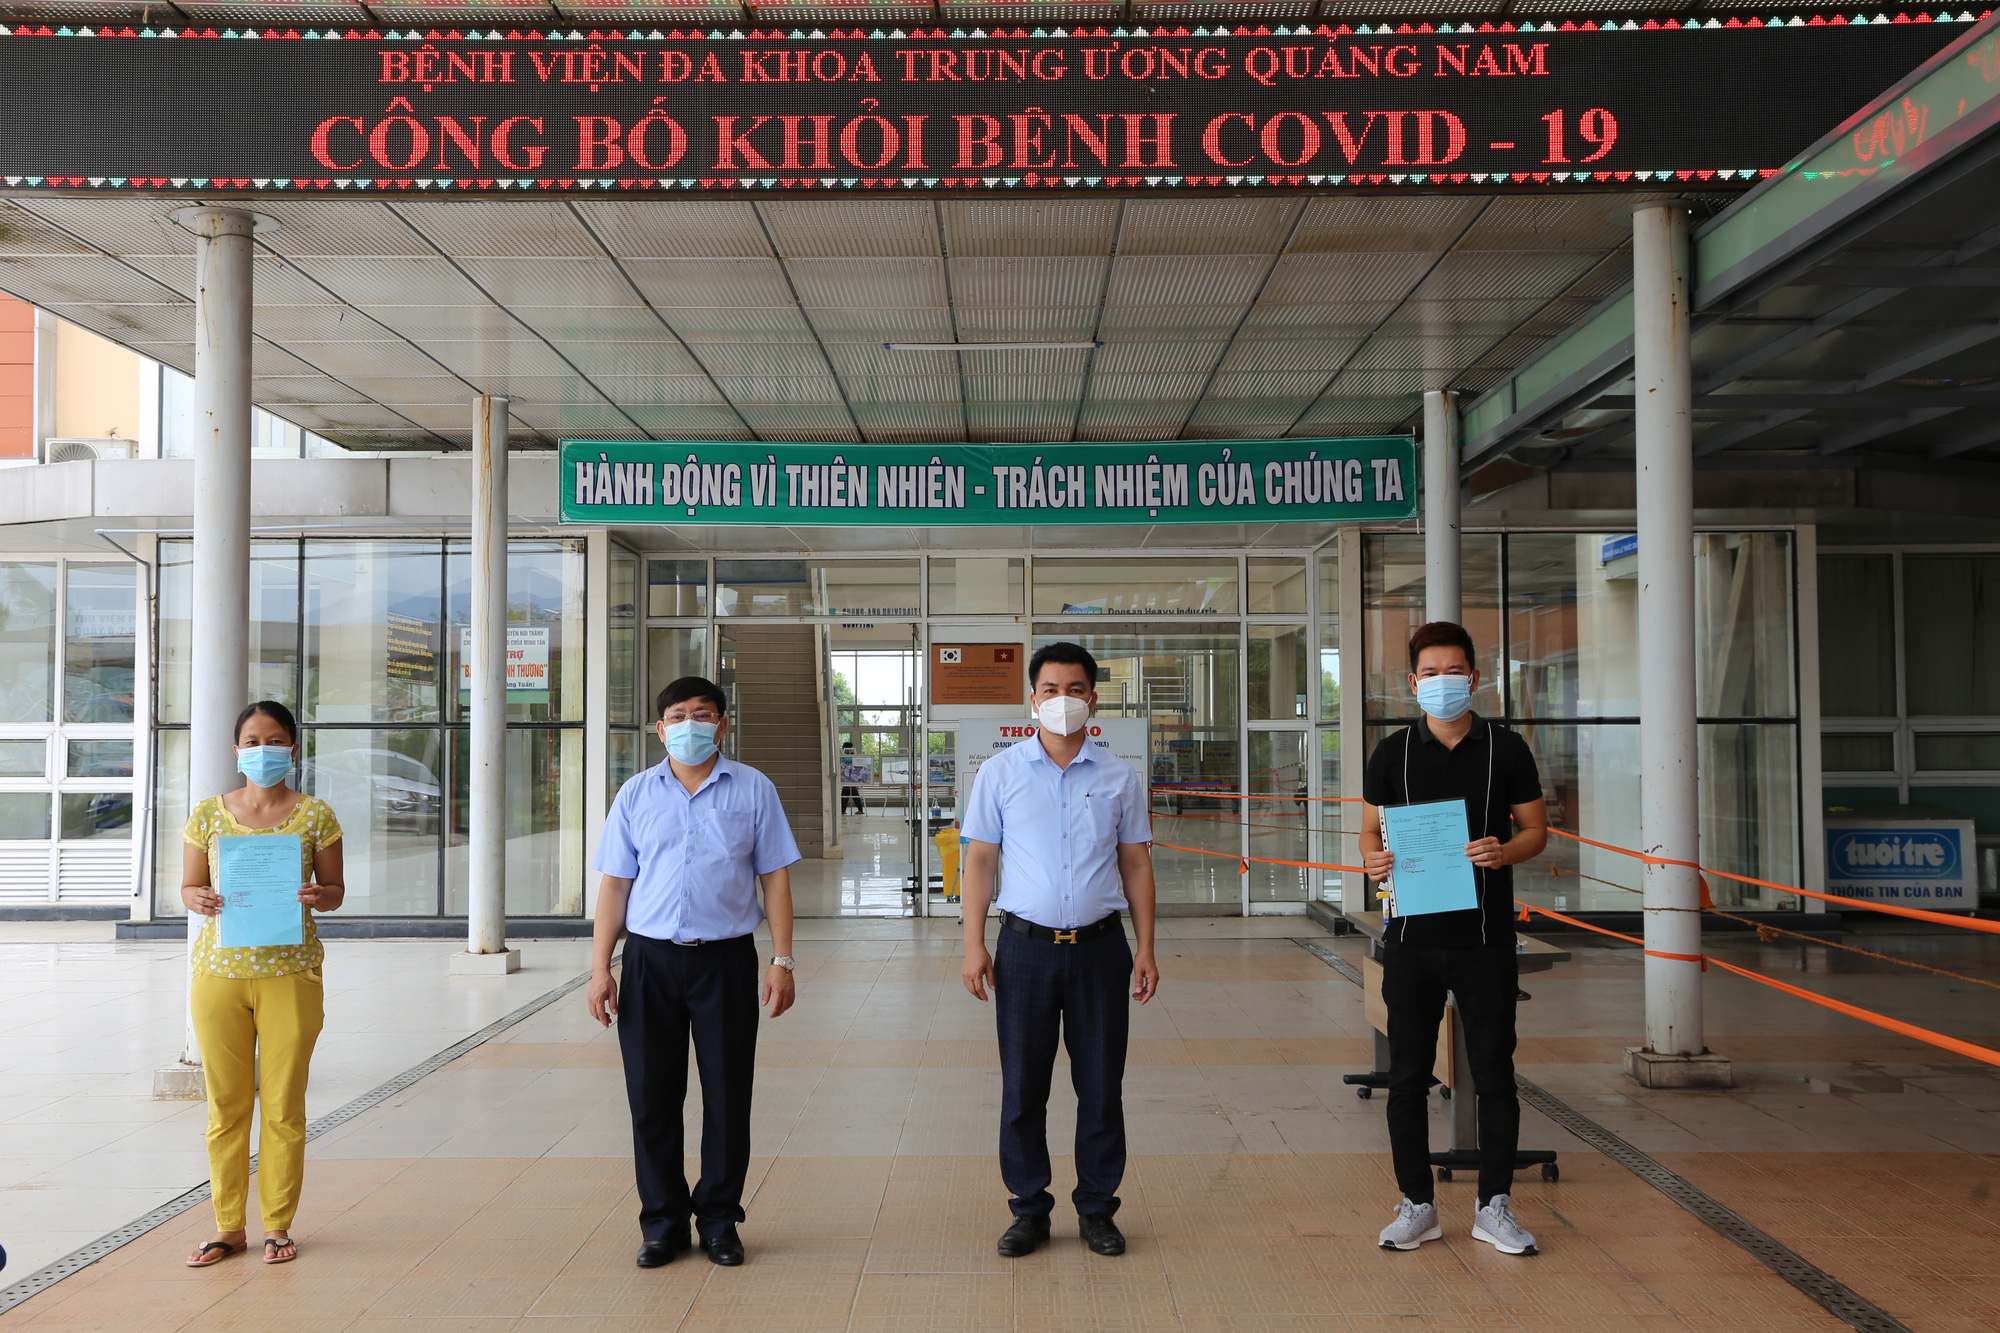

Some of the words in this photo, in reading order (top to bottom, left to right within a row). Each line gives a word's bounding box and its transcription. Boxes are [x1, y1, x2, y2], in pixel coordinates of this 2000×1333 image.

[379, 44, 515, 92] BỆNH
[528, 43, 647, 92] VIỆN
[658, 50, 728, 83] ĐA
[739, 49, 881, 83] KHOA
[896, 47, 1068, 82] TRUNG
[1081, 41, 1231, 80] ƯƠNG
[1244, 33, 1423, 86] QUẢNG
[1434, 42, 1550, 78] NAM
[310, 96, 550, 170] CÔNG
[573, 96, 688, 170] BỐ
[711, 98, 929, 170] KHỎI
[1202, 109, 1466, 168] COVID
[1541, 108, 1618, 165] 19
[575, 453, 655, 506] HÀNH
[661, 454, 742, 516] ĐỘNG
[750, 454, 777, 507] VÌ
[784, 455, 868, 508] THIÊN
[876, 456, 966, 508] NHIÊN
[973, 485, 987, 496] -
[992, 456, 1086, 508] TRÁCH
[1094, 454, 1189, 517] NHIỆM
[1197, 447, 1257, 507] CỦA
[1264, 451, 1363, 505] CHÚNG
[1371, 458, 1405, 502] TA
[1000, 724, 1039, 737] THÔ
[1878, 886, 1899, 898] TIN
[1904, 882, 1931, 898] CỦA
[1935, 886, 1963, 900] BẠN
